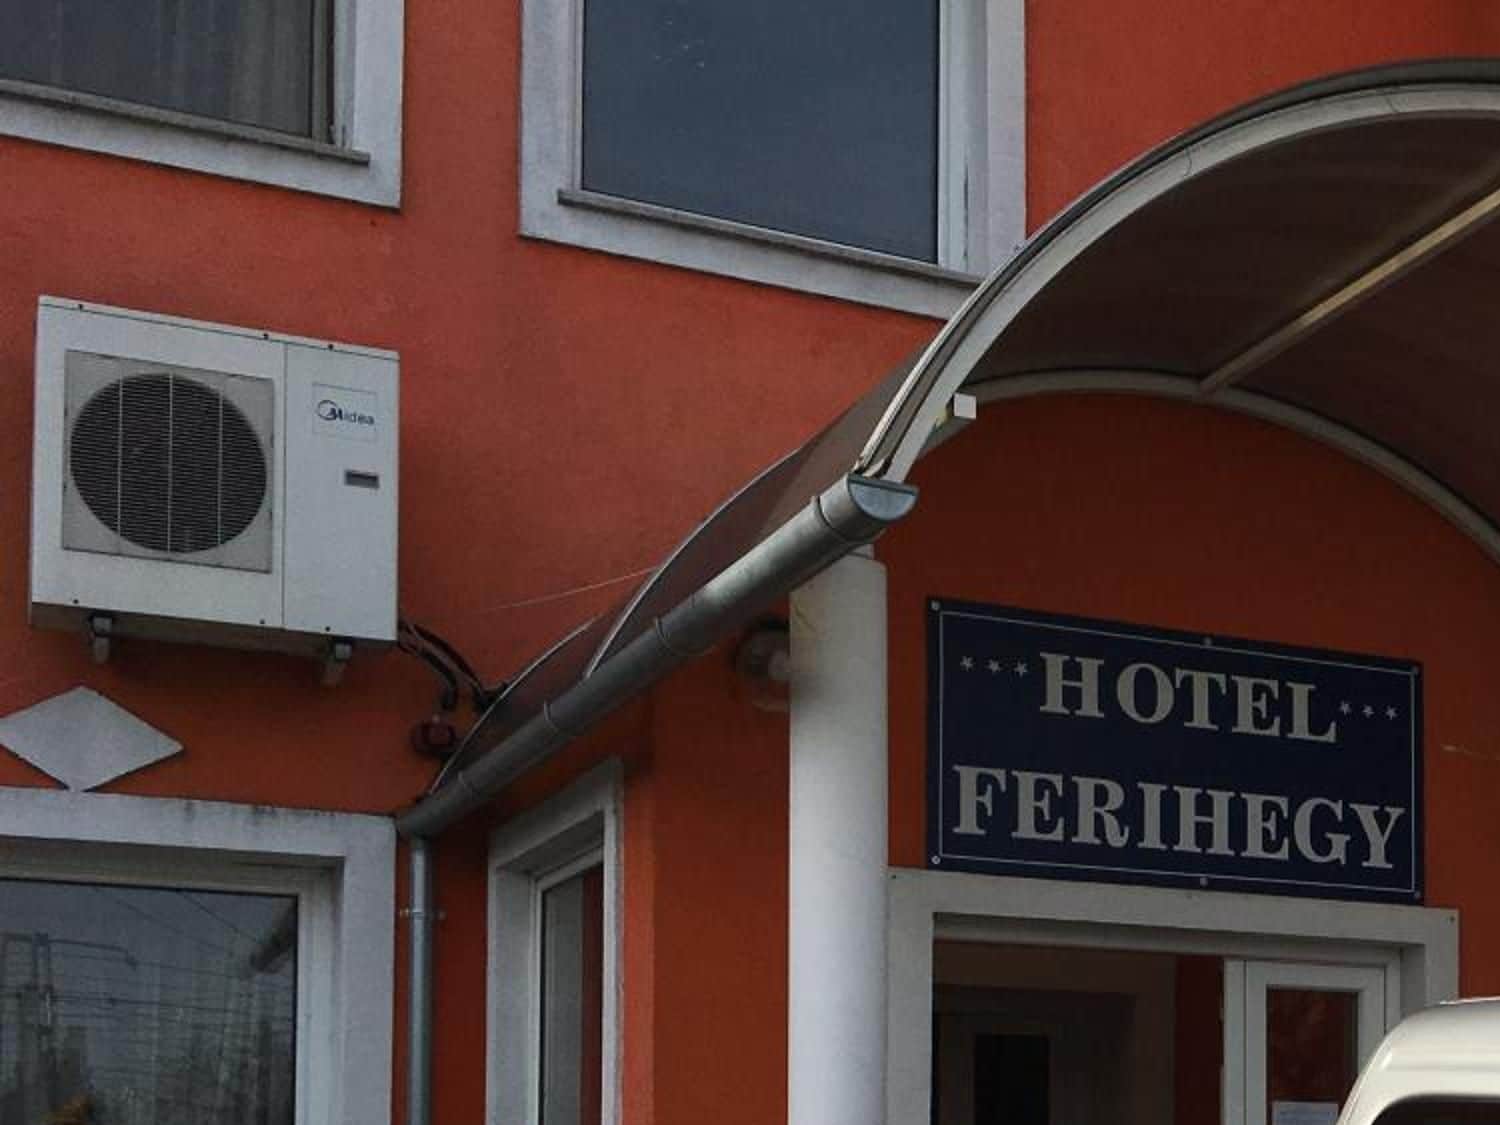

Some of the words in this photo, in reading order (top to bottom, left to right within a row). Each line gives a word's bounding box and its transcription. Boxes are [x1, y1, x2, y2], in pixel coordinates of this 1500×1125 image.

[316, 399, 375, 425] Midea
[1039, 652, 1337, 743] HOTEL
[952, 764, 1404, 869] FERIHEGY
